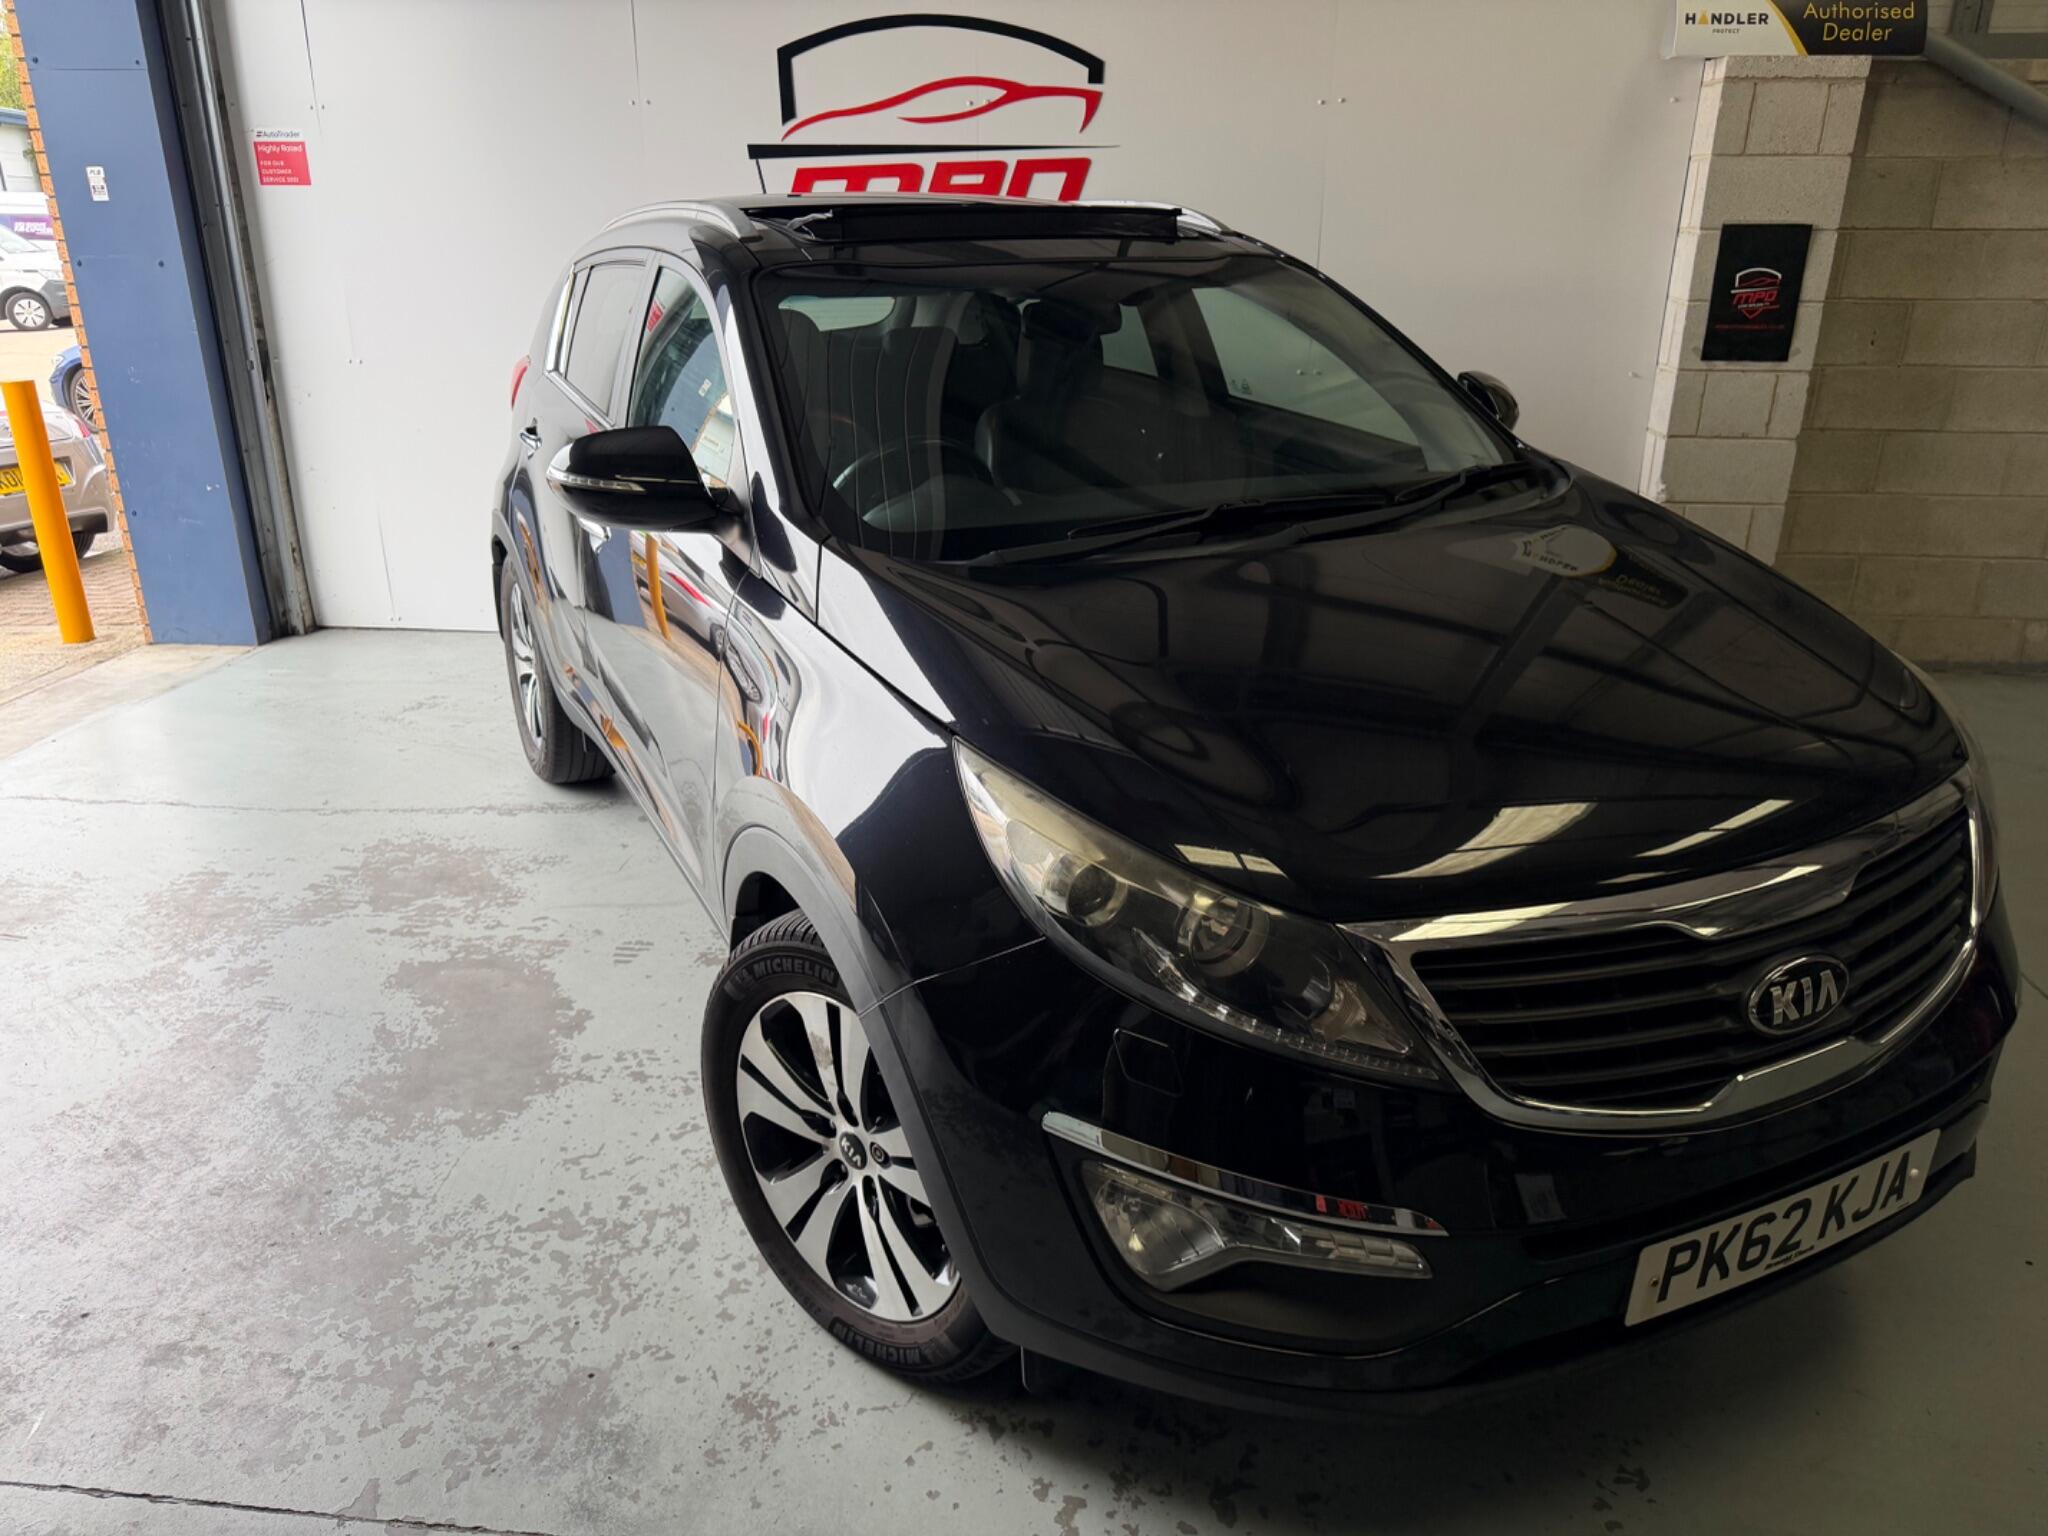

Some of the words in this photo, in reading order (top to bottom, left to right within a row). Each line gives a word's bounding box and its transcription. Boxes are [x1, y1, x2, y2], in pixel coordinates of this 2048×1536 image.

[1803, 1, 1915, 20] Authorised
[1823, 23, 1892, 41] Dealer
[257, 144, 280, 154] Highly
[281, 144, 302, 153] Rated
[752, 957, 836, 984] MICHELIN
[1769, 969, 1839, 1026] KIA
[841, 1136, 862, 1168] KIA
[1656, 1199, 1813, 1303] PK62
[1817, 1152, 1911, 1241] KJA
